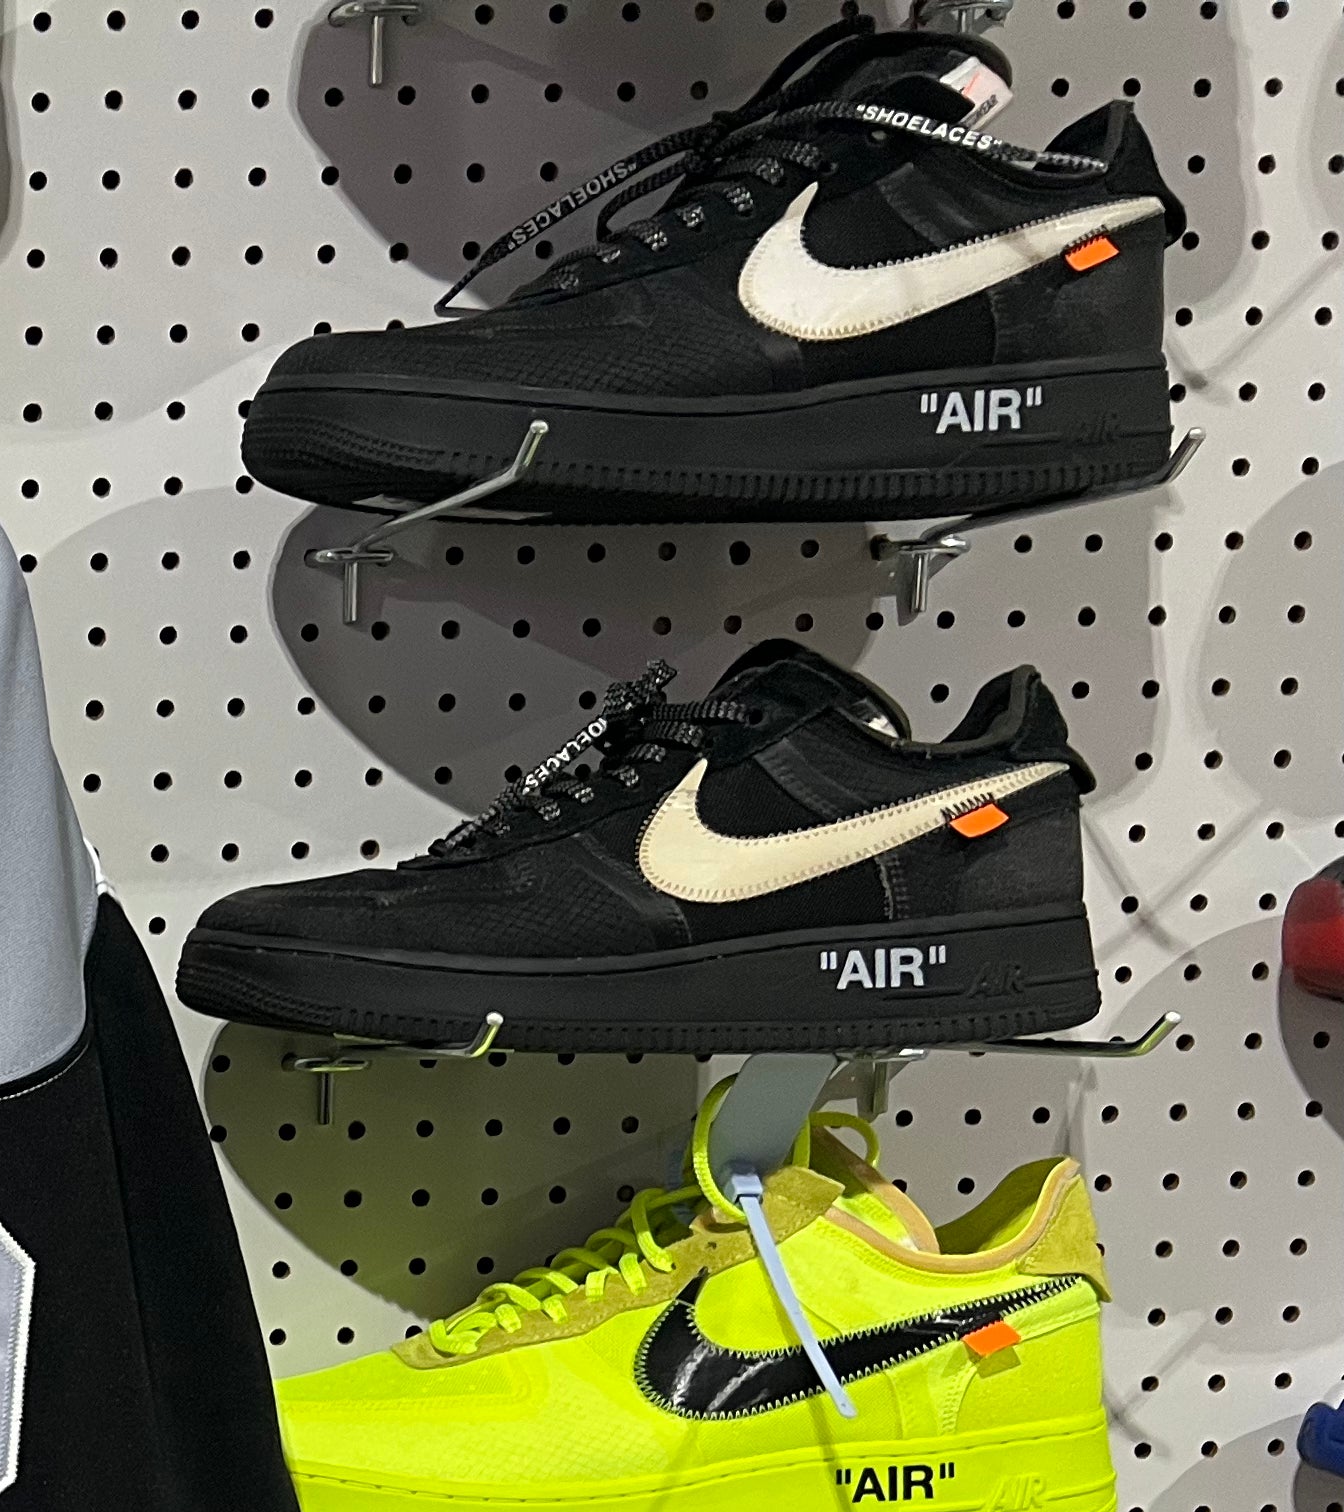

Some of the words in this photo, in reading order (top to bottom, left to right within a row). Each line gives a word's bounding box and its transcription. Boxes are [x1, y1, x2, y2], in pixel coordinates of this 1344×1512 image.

[920, 385, 1043, 434] "AIR"
[819, 944, 947, 990] "AIR"
[835, 1461, 956, 1504] "AIR"
